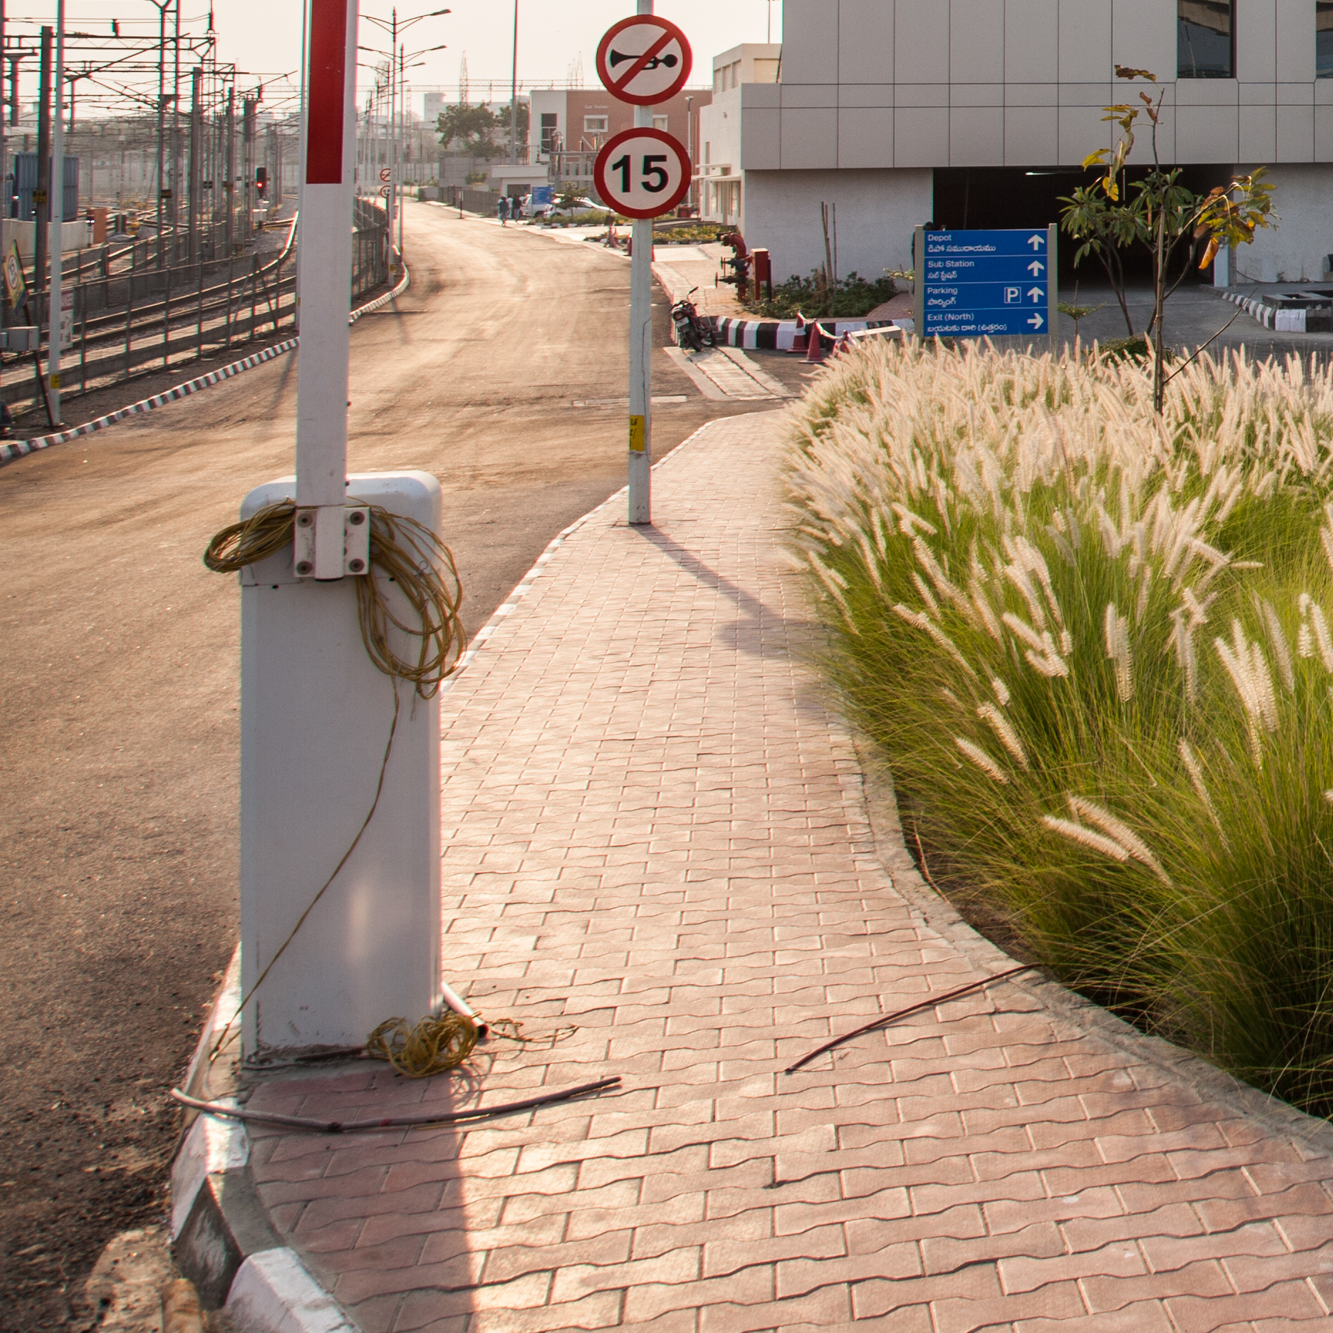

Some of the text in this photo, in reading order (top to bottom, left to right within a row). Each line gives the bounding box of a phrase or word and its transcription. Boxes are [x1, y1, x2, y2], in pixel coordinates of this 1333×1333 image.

[612, 155, 669, 193] 15
[927, 234, 952, 242] Depot
[928, 260, 944, 268] Sub
[927, 287, 958, 295] Parking
[1006, 287, 1019, 303] P
[944, 313, 975, 322] (North)
